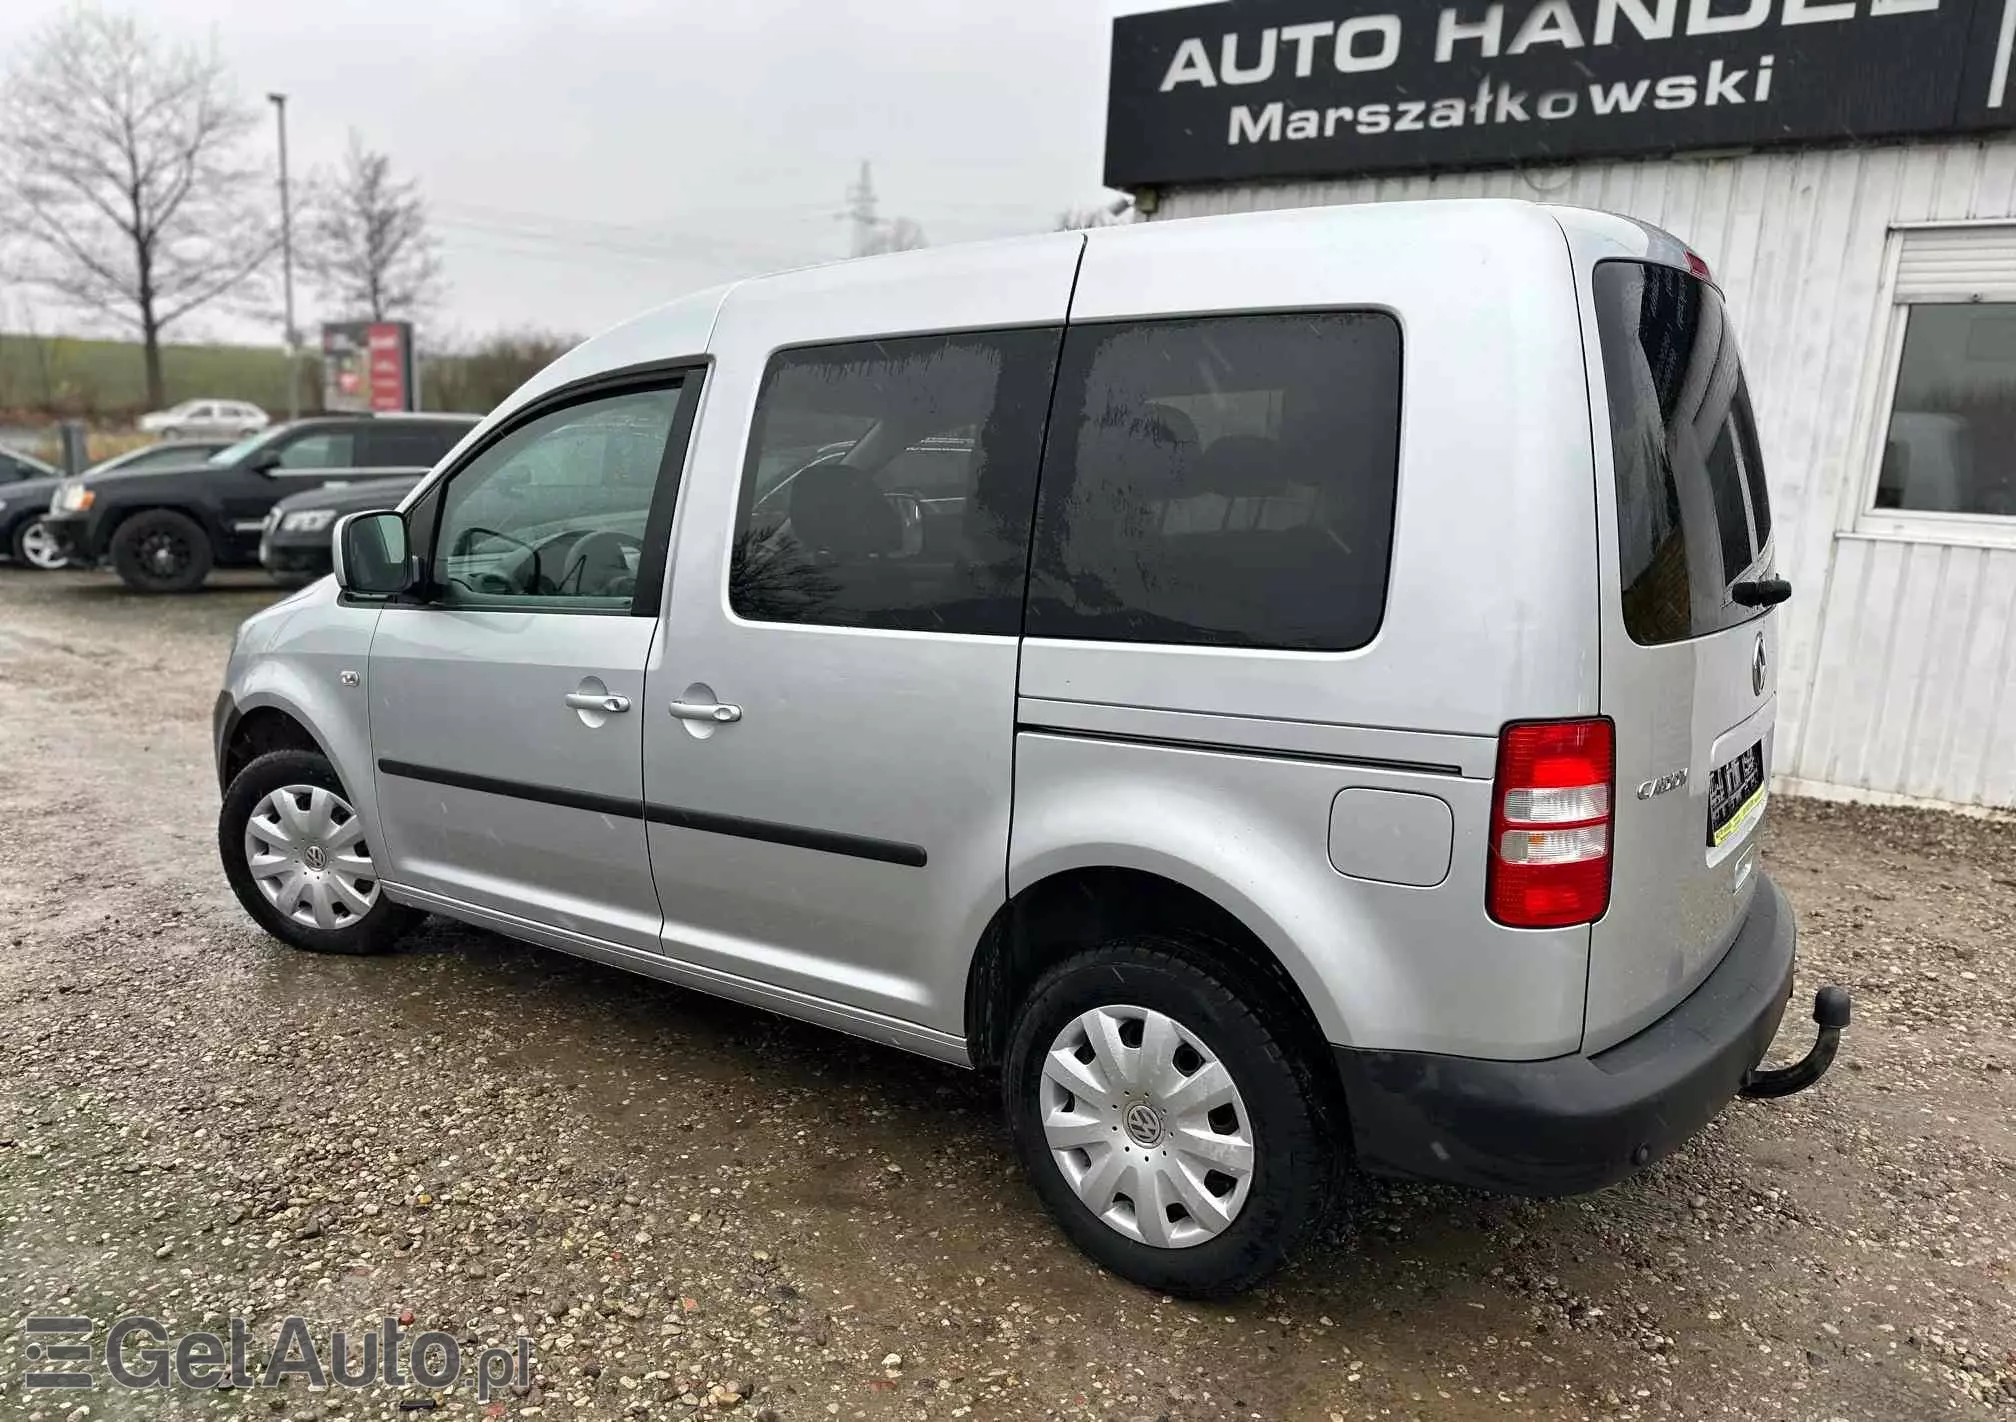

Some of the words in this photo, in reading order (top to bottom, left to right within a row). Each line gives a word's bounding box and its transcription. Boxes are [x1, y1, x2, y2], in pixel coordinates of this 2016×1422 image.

[1159, 14, 1402, 93] AUTO
[1433, 0, 1941, 63] HAND
[1227, 54, 1775, 146] Marszałkowski
